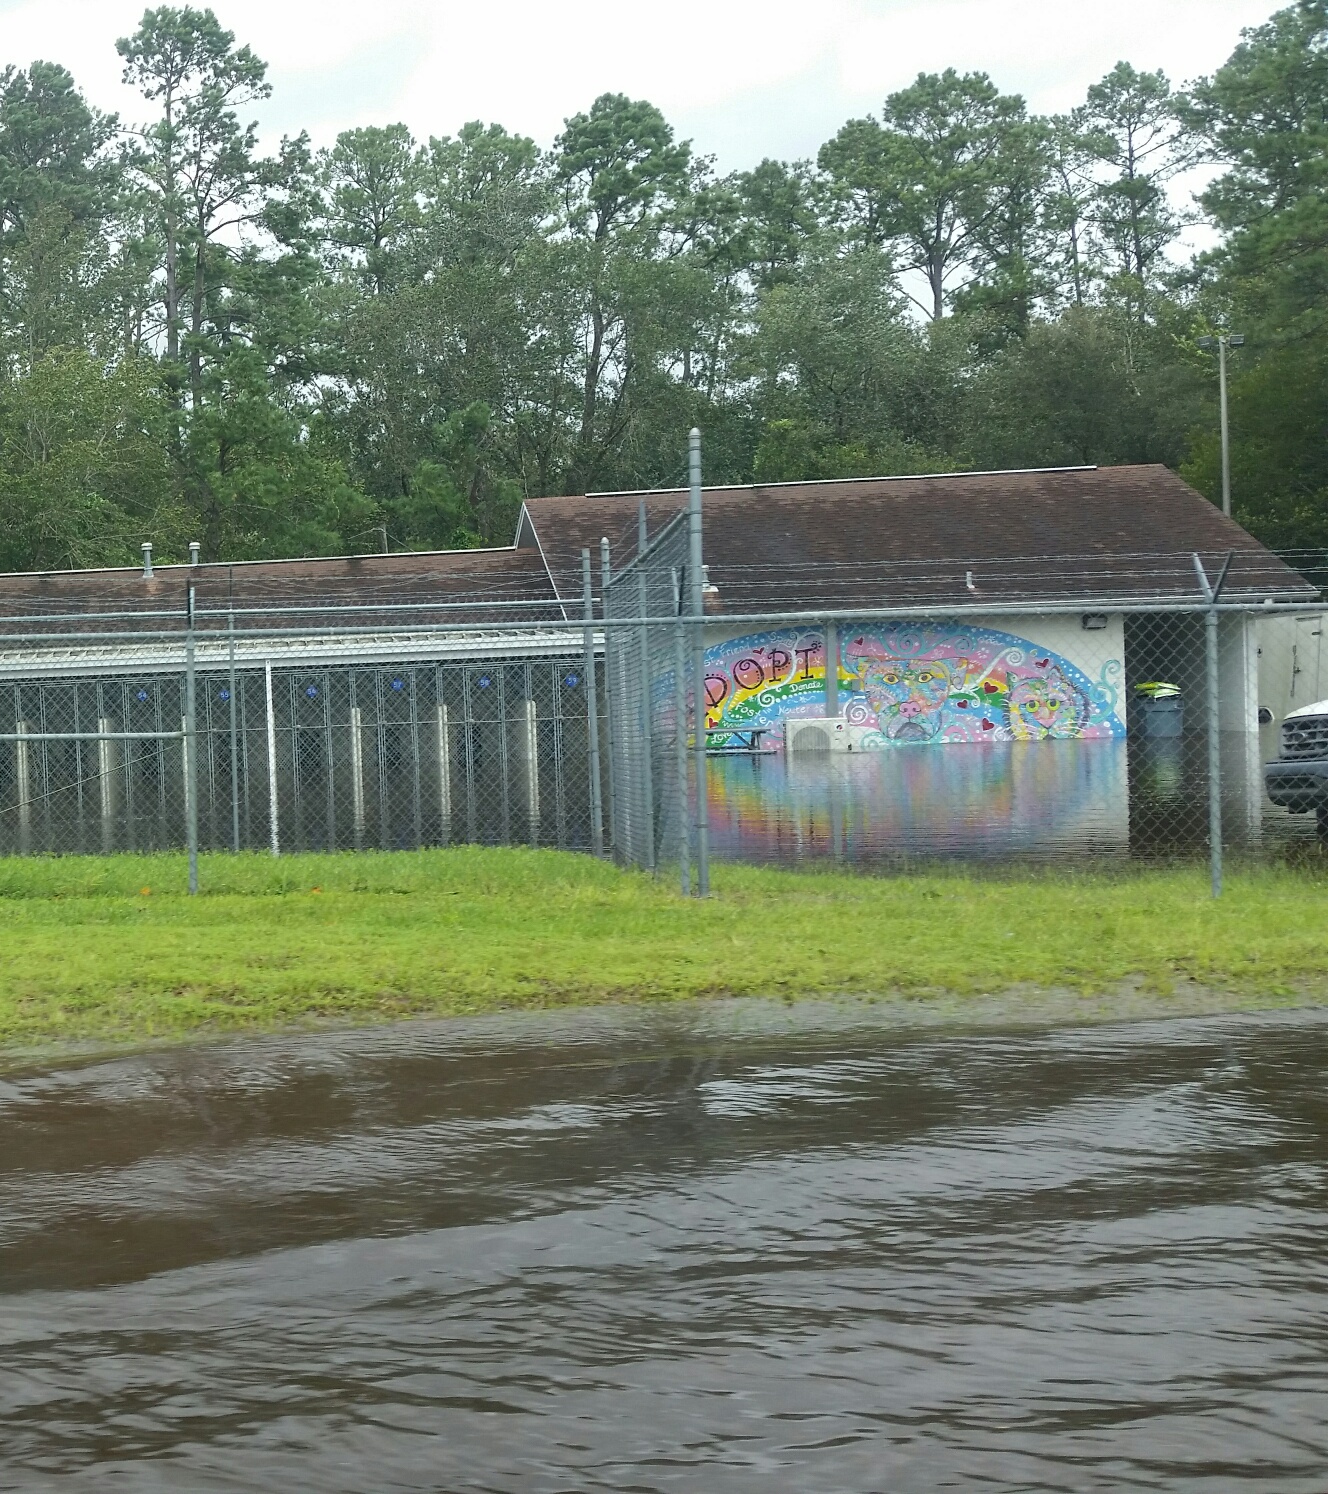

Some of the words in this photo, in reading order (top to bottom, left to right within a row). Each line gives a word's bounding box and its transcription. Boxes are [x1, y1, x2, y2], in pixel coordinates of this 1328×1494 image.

[720, 642, 751, 658] Friend
[688, 641, 819, 713] DOPT
[789, 681, 823, 693] Donate
